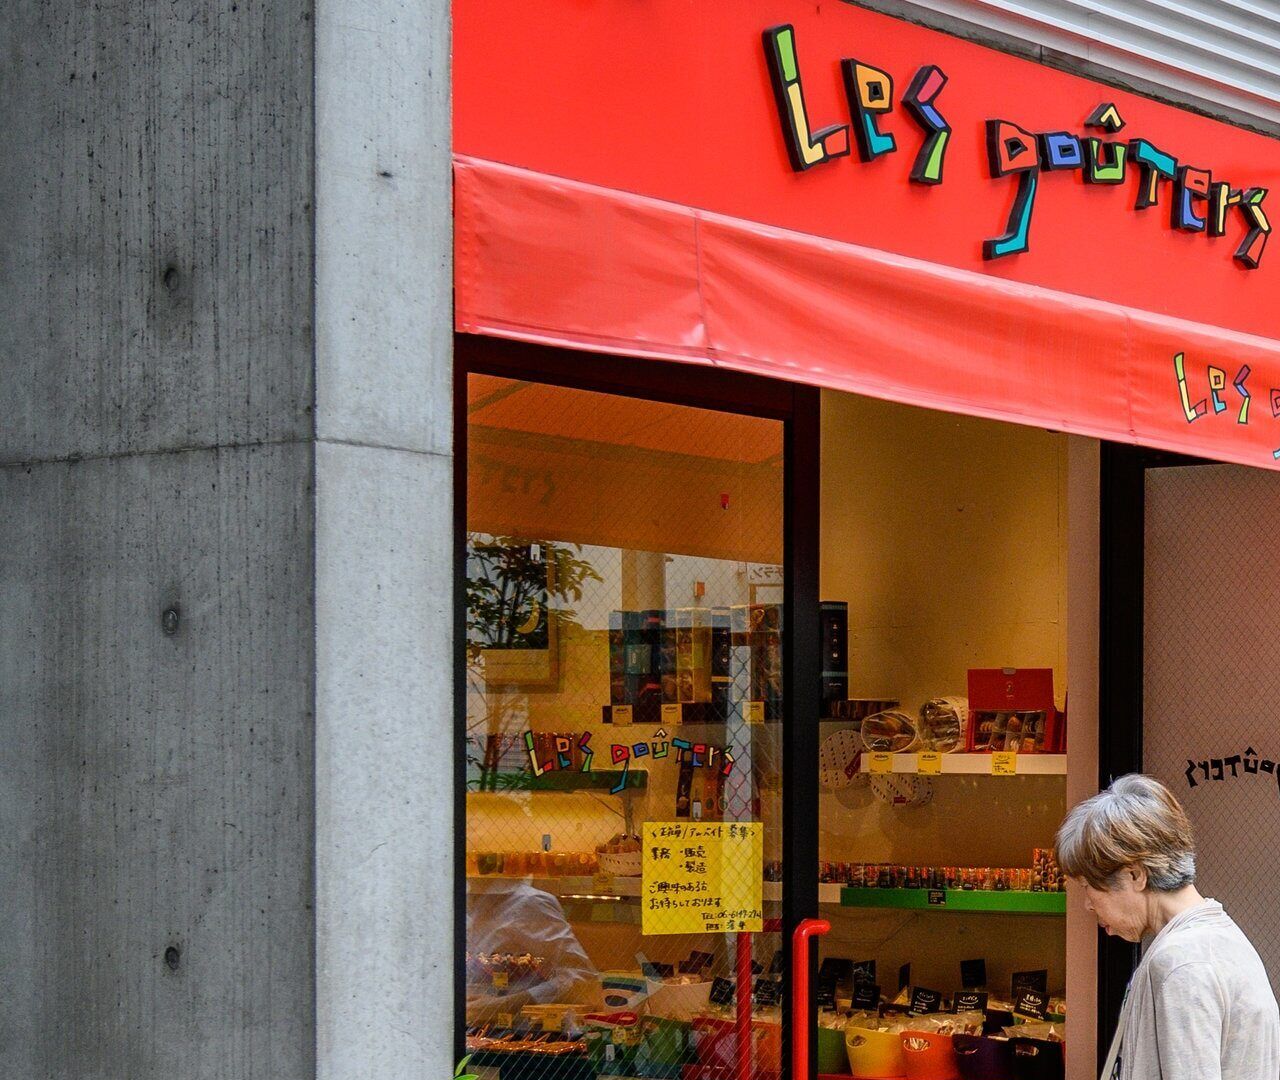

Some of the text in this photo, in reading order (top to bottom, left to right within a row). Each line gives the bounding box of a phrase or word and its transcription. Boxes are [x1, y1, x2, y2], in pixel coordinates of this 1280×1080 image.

[761, 23, 953, 186] Les
[1173, 352, 1251, 424] Les
[524, 730, 594, 777] Les
